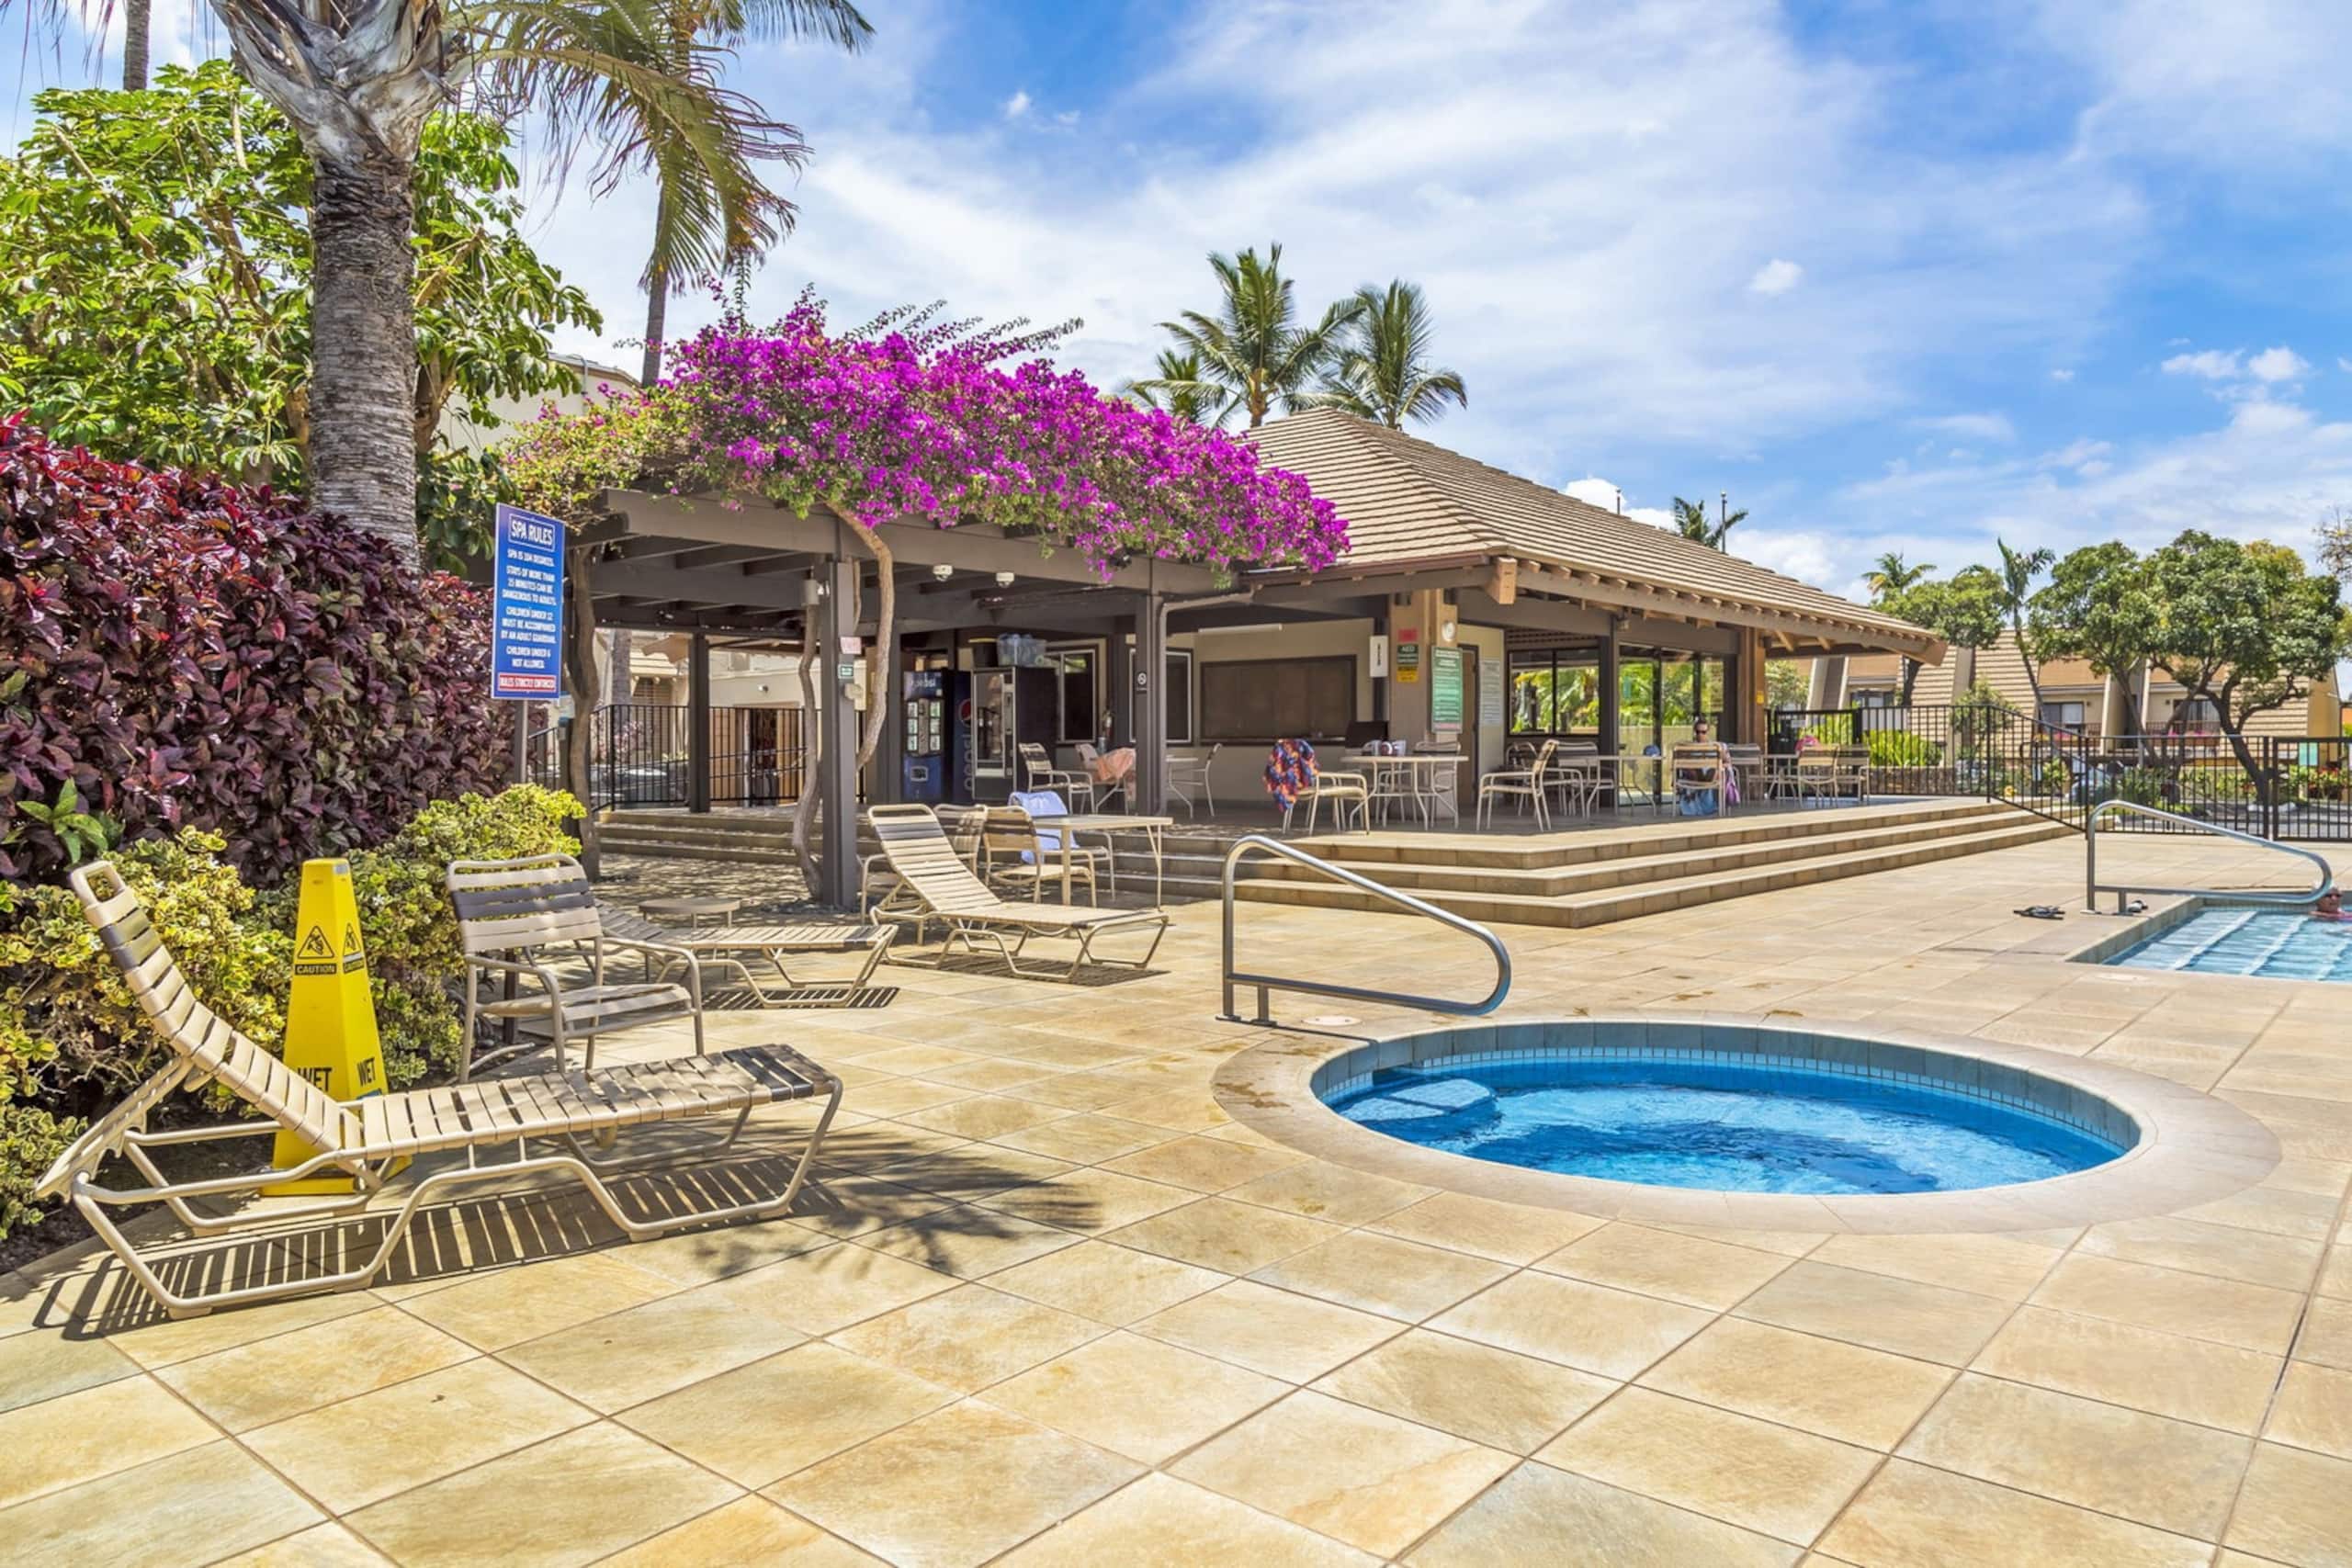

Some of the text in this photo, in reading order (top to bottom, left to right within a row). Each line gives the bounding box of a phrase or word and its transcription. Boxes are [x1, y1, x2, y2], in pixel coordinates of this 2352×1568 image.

[512, 520, 553, 546] SPA RULES
[296, 964, 335, 974] CAUTION
[356, 1057, 376, 1087] WET
